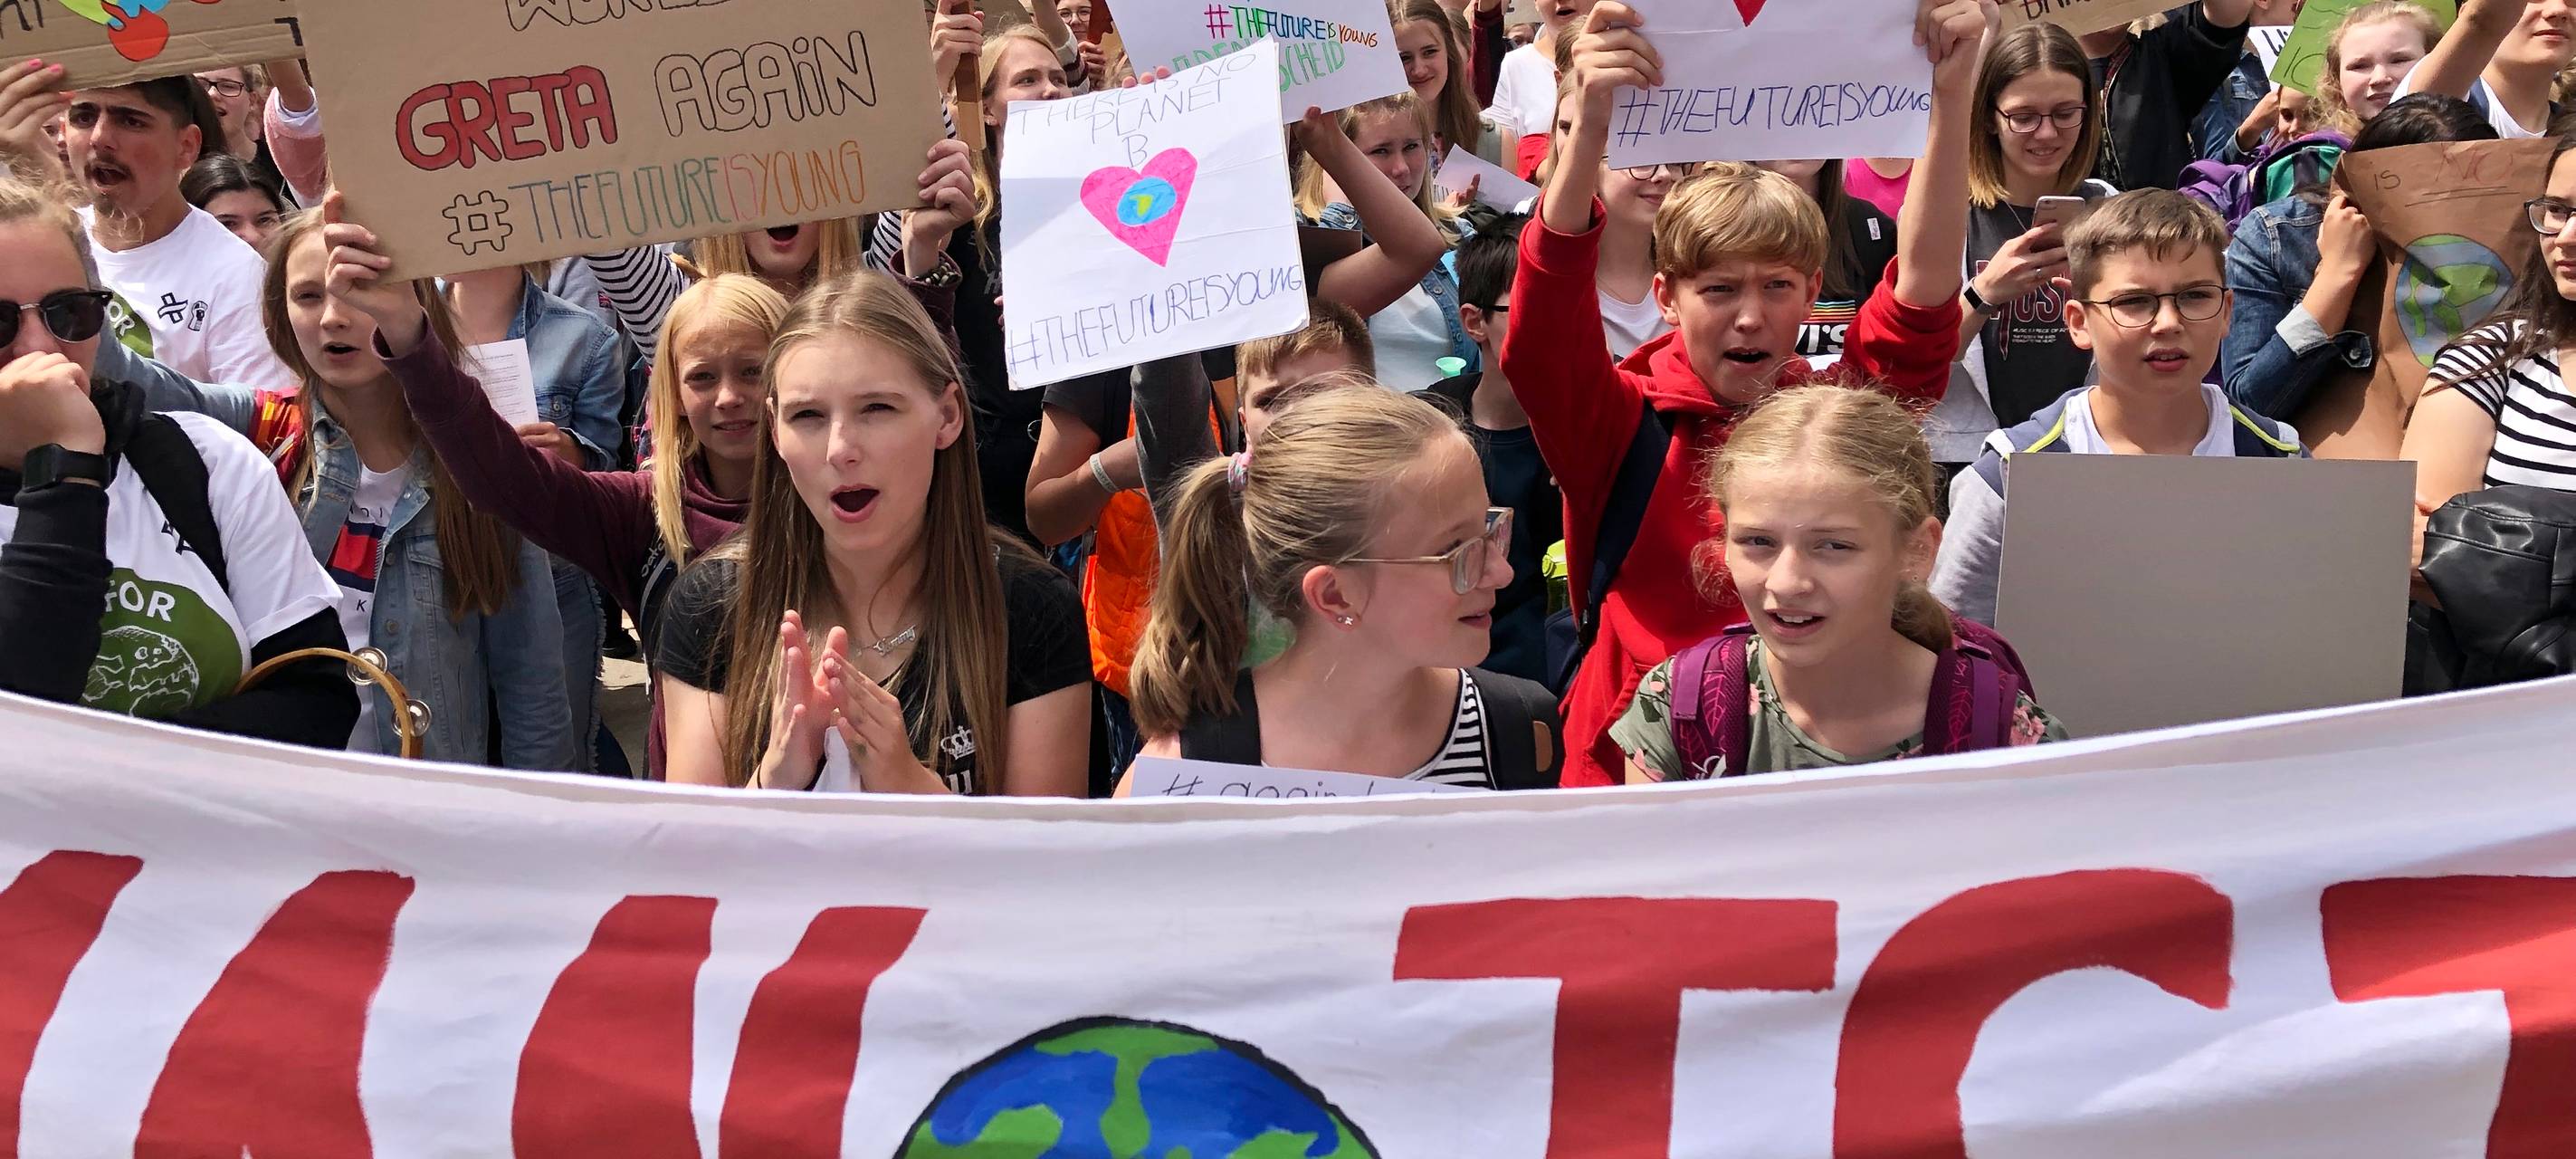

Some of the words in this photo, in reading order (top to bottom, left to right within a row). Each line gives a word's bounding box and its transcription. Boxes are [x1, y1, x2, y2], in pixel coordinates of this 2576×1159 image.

[396, 64, 618, 171] GRETA
[1009, 89, 1140, 136] THERE
[1196, 53, 1256, 83] NO
[1085, 76, 1232, 145] PLANET
[1617, 81, 1932, 148] #THEFUTUREISYOUNG
[1121, 133, 1149, 168] B
[2373, 169, 2401, 190] IS
[442, 139, 866, 256] #THEFUTUREISYOUNG
[1007, 263, 1303, 376] #THEFUTUREISYOUNG
